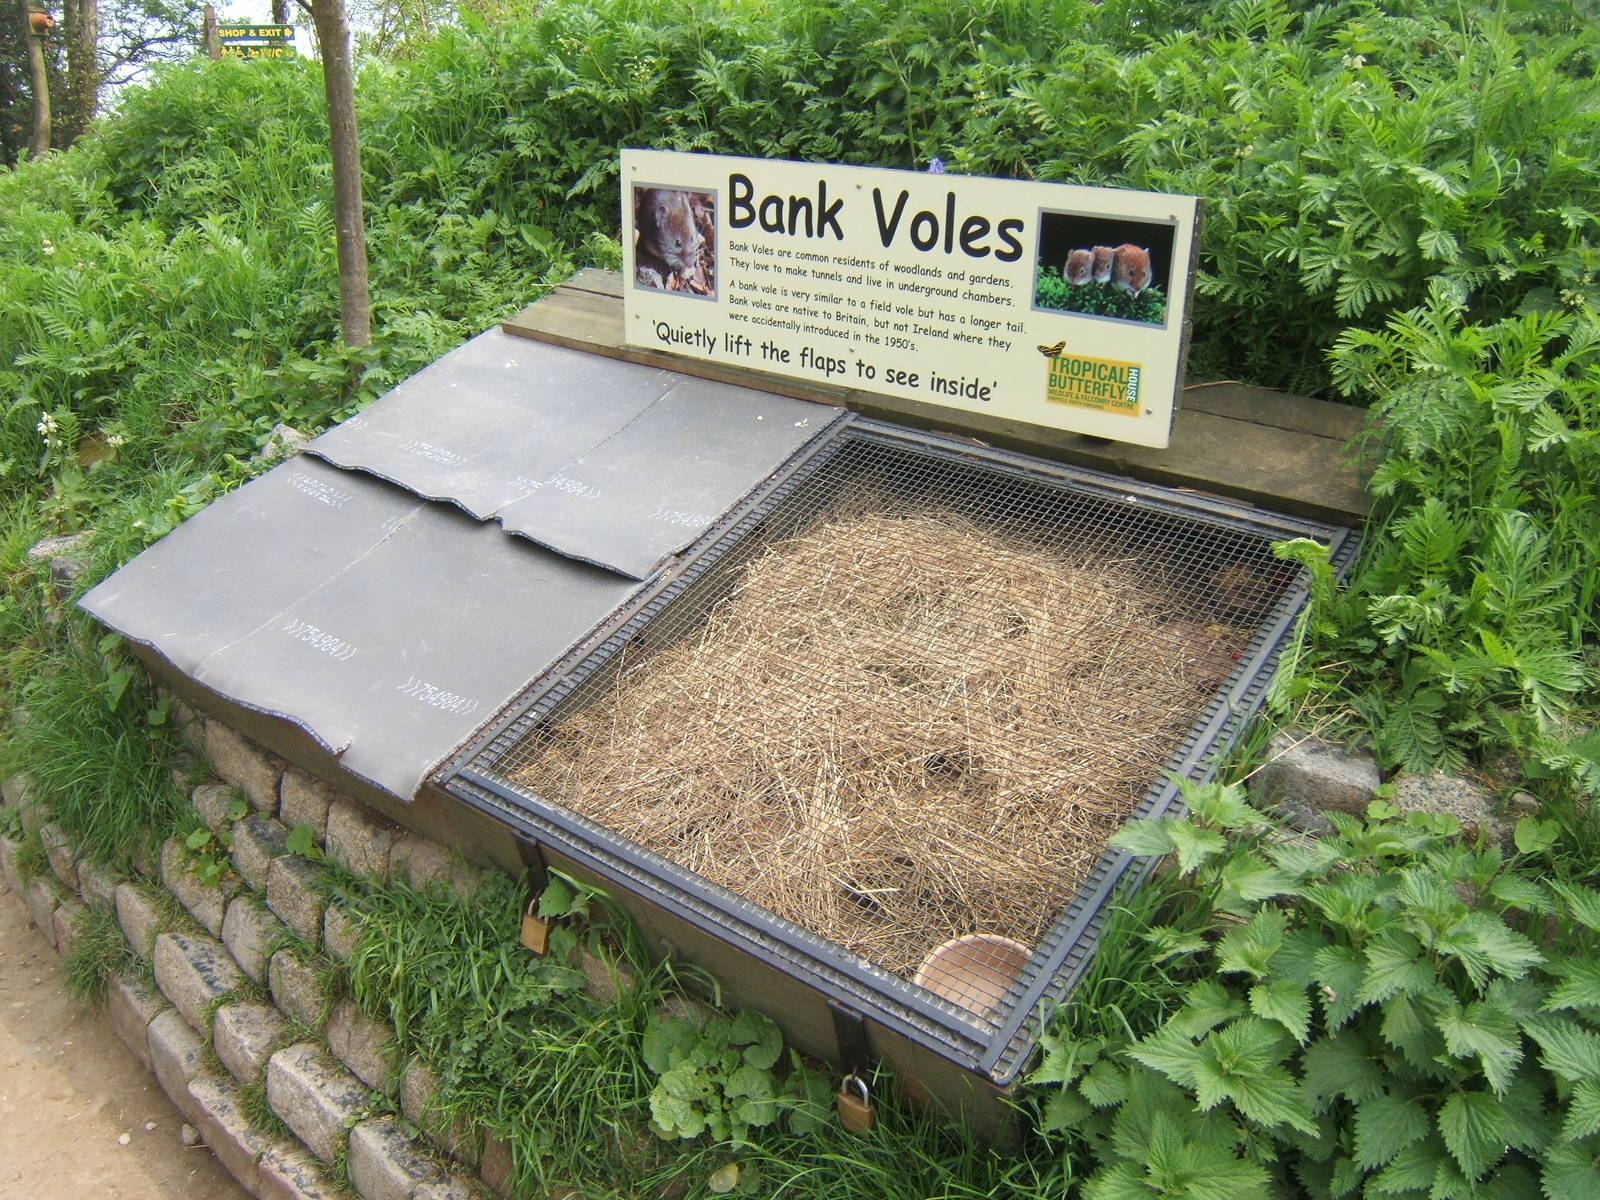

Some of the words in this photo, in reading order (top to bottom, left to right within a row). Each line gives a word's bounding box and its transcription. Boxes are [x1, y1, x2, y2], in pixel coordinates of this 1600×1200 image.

[219, 29, 246, 37] SHOP
[249, 29, 256, 37] &
[259, 29, 281, 37] EXIT
[729, 173, 843, 240] Bank
[873, 188, 1024, 262] Voles
[730, 241, 748, 252] Bank
[752, 244, 773, 255] Voles
[796, 252, 829, 263] common
[833, 256, 875, 268] residents
[880, 261, 889, 270] of
[894, 264, 942, 277] woodlands
[948, 271, 965, 281] and
[969, 275, 1013, 288] gardens.
[730, 257, 750, 271] They
[754, 261, 769, 271] love
[774, 265, 781, 273] to
[786, 267, 807, 276] make
[812, 270, 842, 281] tunnels
[847, 275, 862, 285] and
[867, 274, 882, 288] live
[886, 279, 894, 289] in
[899, 283, 958, 297] underground
[963, 291, 1015, 307] chambers.
[729, 280, 735, 288] A
[739, 280, 757, 291] bank
[761, 285, 777, 294] vole
[781, 287, 788, 296] is
[792, 290, 810, 302] very
[814, 292, 842, 304] similar
[848, 298, 856, 307] to
[870, 300, 892, 312] field
[896, 305, 914, 316] vole
[918, 307, 934, 318] but
[939, 311, 955, 321] has
[971, 315, 1001, 330] longer
[1007, 321, 1027, 334] tail.
[729, 294, 748, 306] Bank
[752, 299, 771, 310] voles
[775, 304, 789, 312] are
[793, 307, 818, 318] native
[823, 310, 831, 319] to
[836, 312, 869, 327] Britain,
[874, 318, 889, 329] but
[894, 322, 908, 332] not
[913, 324, 949, 339] Ireland
[953, 332, 983, 344] where
[988, 337, 1011, 352] they
[729, 312, 748, 322] were
[752, 315, 800, 332] accidentally
[803, 323, 849, 339] introduced
[854, 331, 860, 341] in
[864, 334, 880, 344] the
[885, 336, 918, 351] 1950's.
[652, 320, 717, 354] 'Quietly
[725, 333, 752, 356] lift
[761, 341, 790, 363] the
[800, 346, 846, 377] flaps
[856, 359, 876, 379] to
[886, 368, 919, 387] see
[930, 371, 997, 401] inside'
[1051, 355, 1128, 385] TROPICAL
[1049, 373, 1127, 400] BUTTERFLY
[1112, 400, 1134, 410] CENTRE
[1127, 367, 1139, 402] HOUSE
